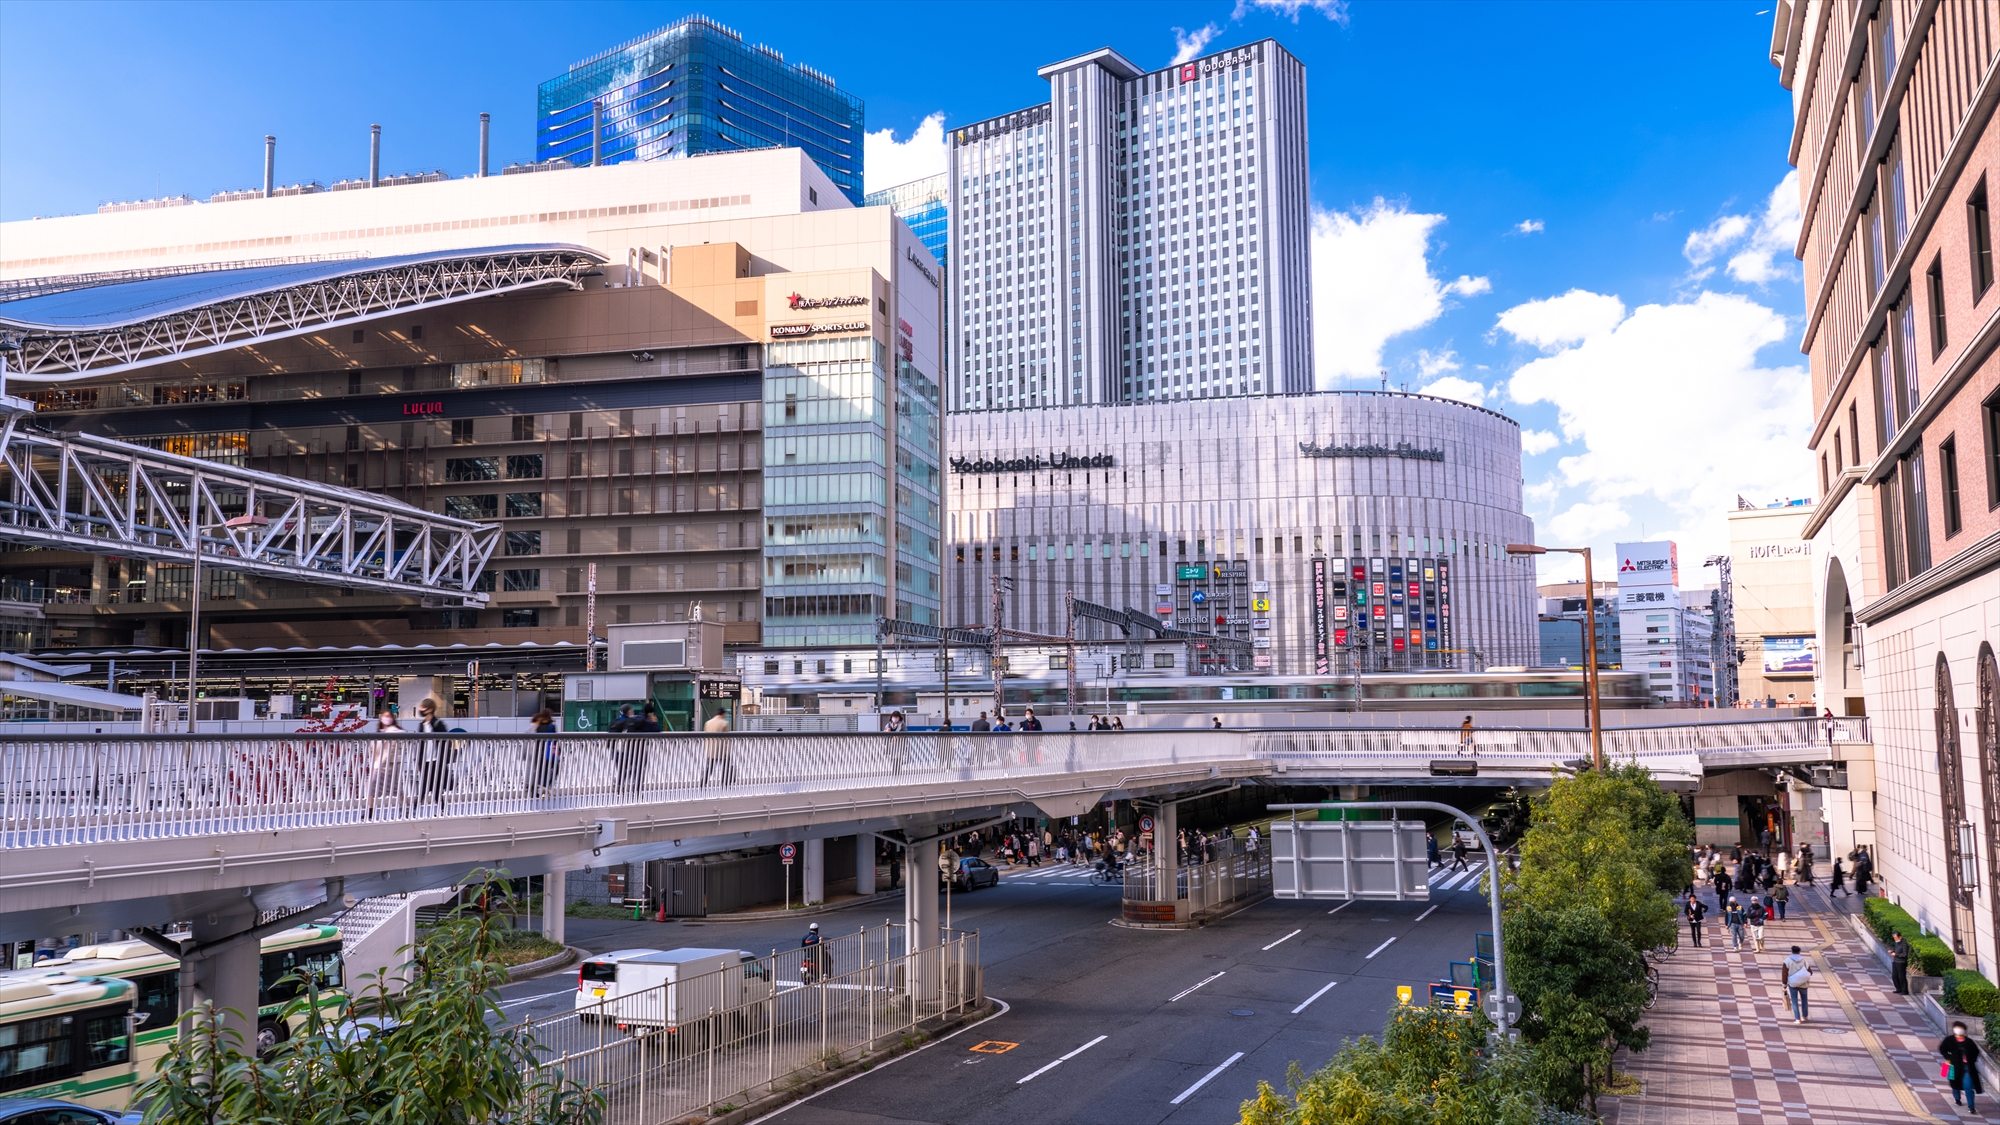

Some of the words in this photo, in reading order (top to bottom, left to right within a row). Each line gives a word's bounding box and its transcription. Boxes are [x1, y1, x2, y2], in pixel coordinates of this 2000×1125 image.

[1199, 52, 1257, 73] YODOBASHI
[1009, 107, 1052, 129] RESPIR
[773, 325, 806, 334] KONAMI
[811, 323, 842, 332] SPORTS
[843, 321, 866, 330] CLUB
[949, 451, 1113, 473] Yodobashi-Umeda
[1626, 592, 1666, 603] 三菱電機
[1179, 615, 1207, 624] anello
